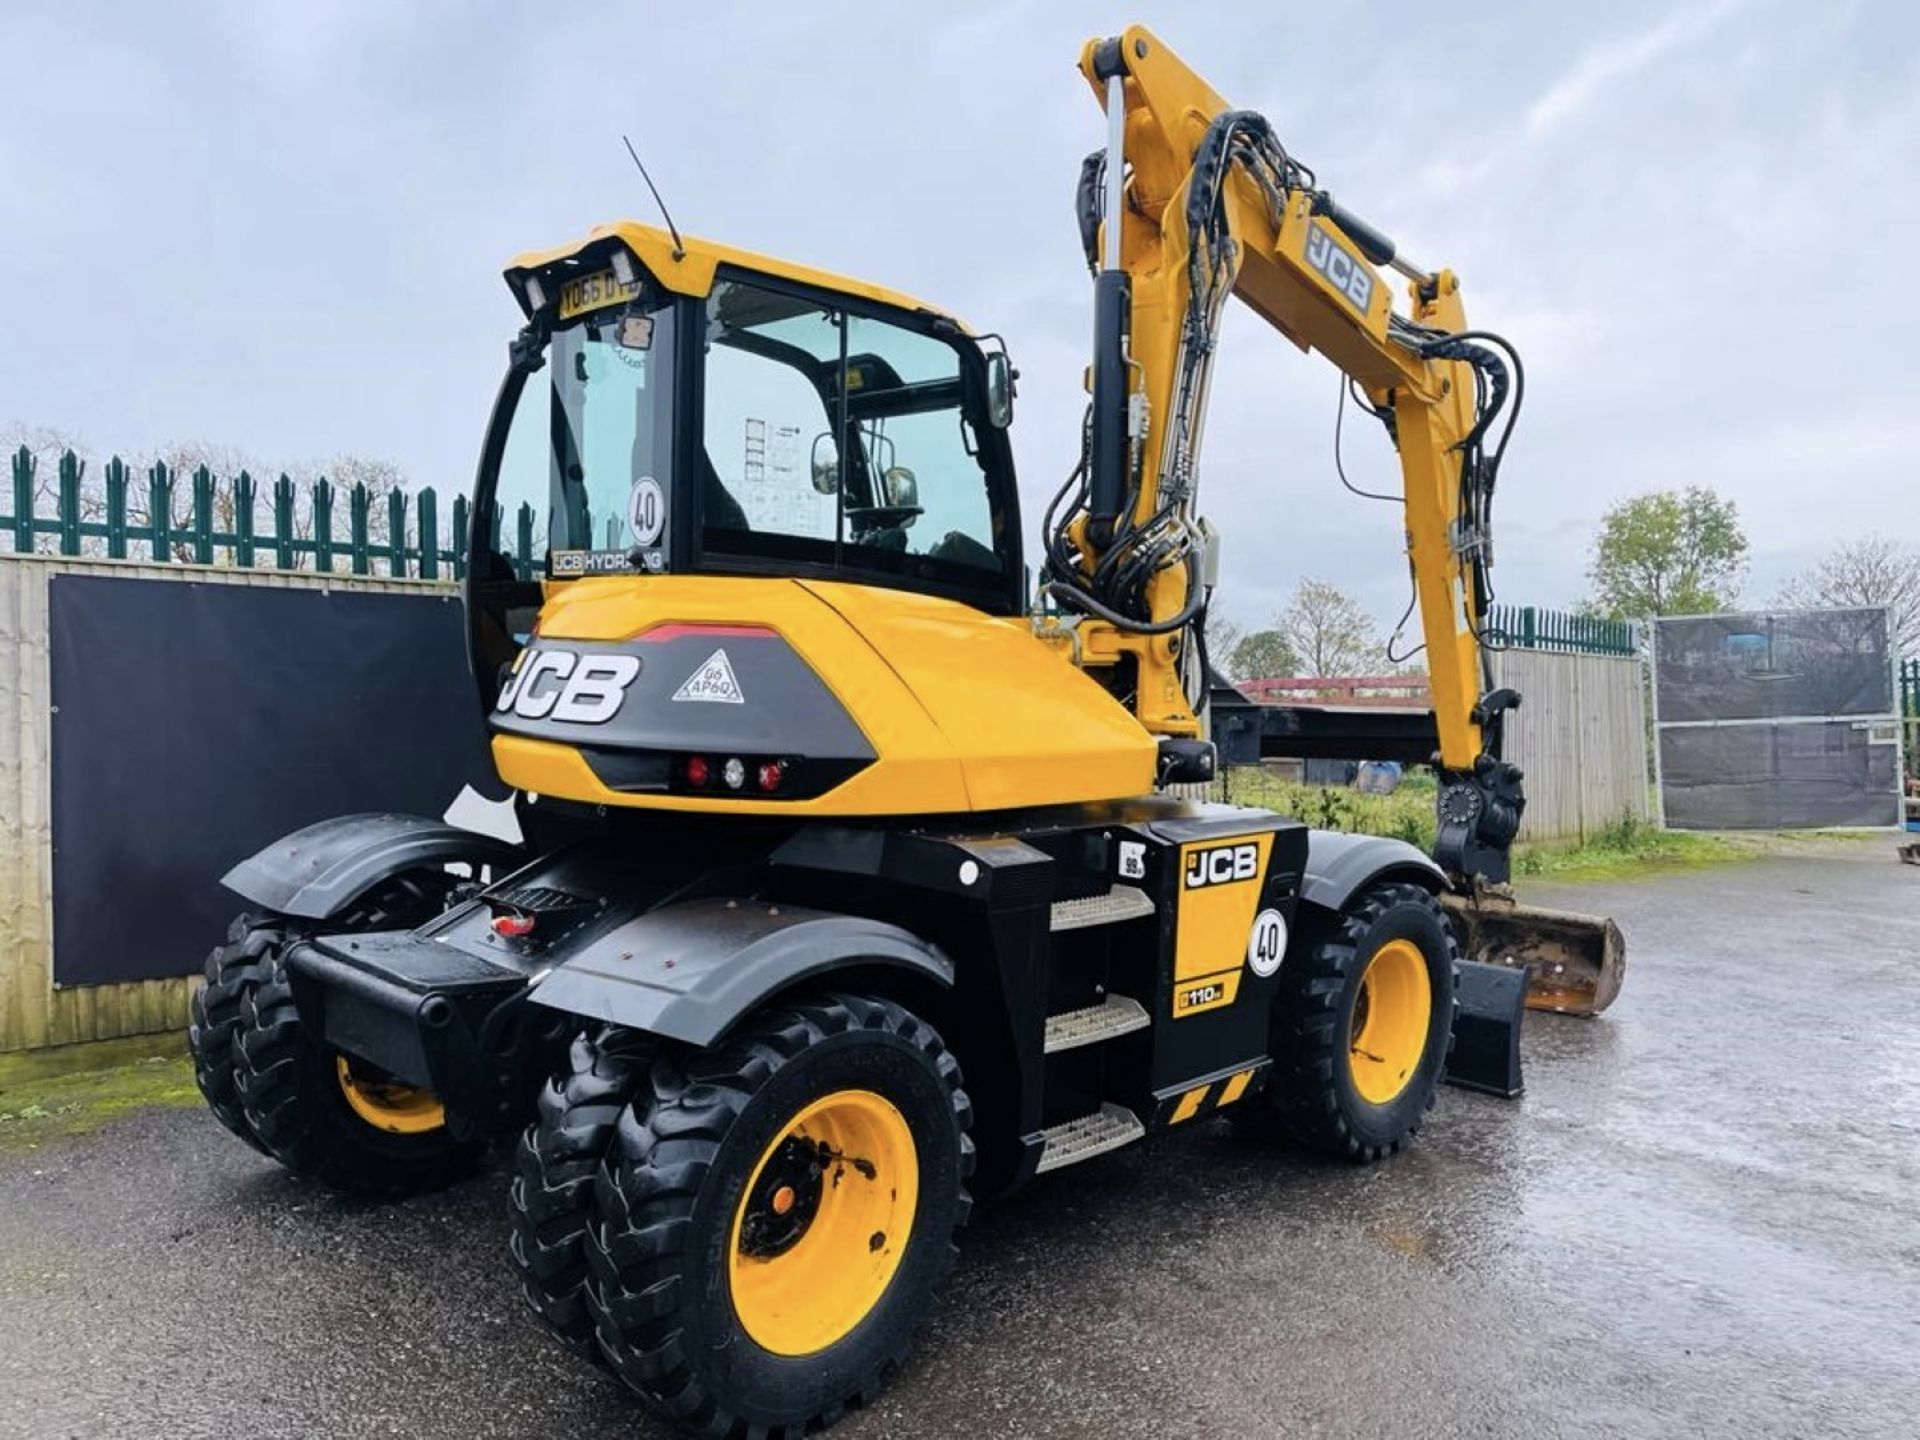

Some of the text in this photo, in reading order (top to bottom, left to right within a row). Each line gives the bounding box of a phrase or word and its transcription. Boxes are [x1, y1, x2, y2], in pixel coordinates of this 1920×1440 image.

[1308, 236, 1372, 310] JCB
[635, 492, 655, 531] 40
[556, 555, 582, 570] JCB
[497, 649, 639, 722] JCB
[1187, 845, 1257, 888] JCB
[1257, 923, 1278, 962] 40
